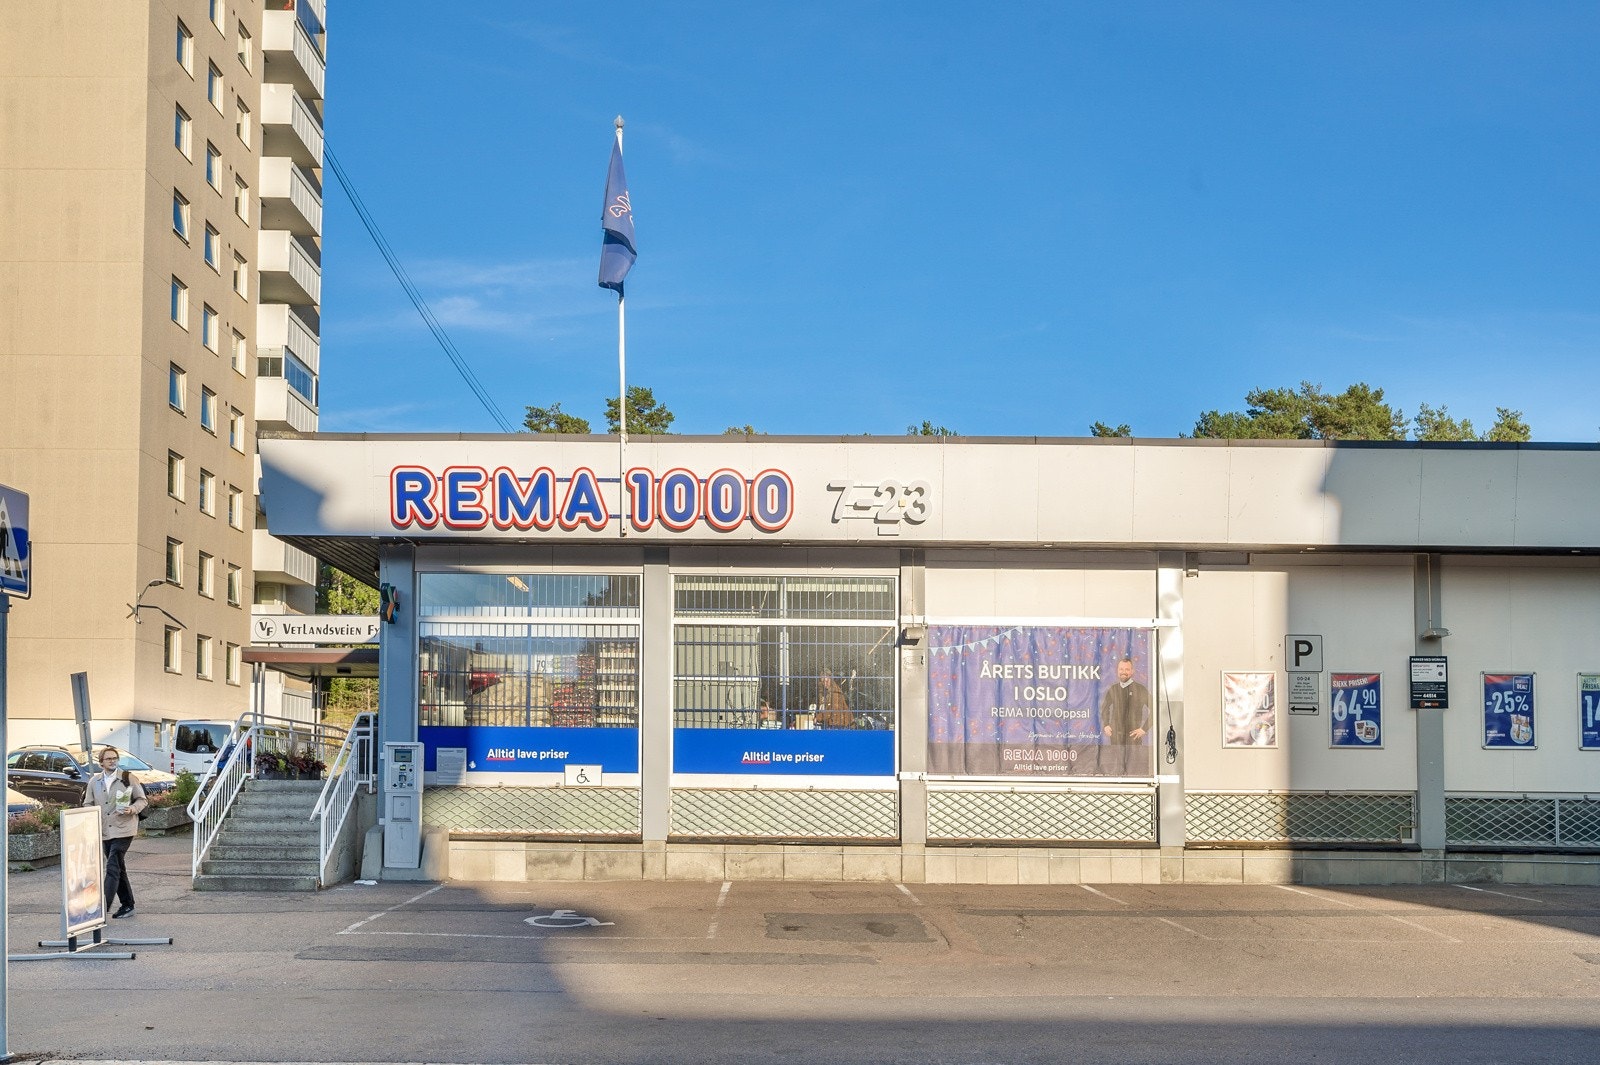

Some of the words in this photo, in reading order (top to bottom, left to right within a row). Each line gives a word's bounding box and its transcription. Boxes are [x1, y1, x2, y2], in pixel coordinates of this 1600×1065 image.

[390, 465, 610, 529] REMA
[625, 467, 794, 531] 1000
[1294, 639, 1313, 667] P
[980, 660, 1034, 679] ÅRETS
[1038, 664, 1101, 680] BUTIKK
[1014, 686, 1019, 701] I
[1023, 686, 1067, 701] OSLO
[1333, 689, 1363, 721] 64
[1362, 689, 1376, 705] 90
[1486, 690, 1529, 714] -25%
[991, 707, 1023, 718] REMA
[1026, 707, 1051, 718] 1000
[1054, 707, 1090, 720] Oppsal
[487, 748, 515, 759] Alltid
[517, 748, 538, 759] lave
[540, 749, 570, 760] priser
[742, 751, 770, 762] Alltid
[772, 752, 793, 762] lave
[795, 752, 825, 764] priser
[1003, 749, 1044, 761] REMA
[1046, 750, 1078, 761] 1000
[1013, 763, 1033, 771] Alltid
[1048, 764, 1068, 772] priser
